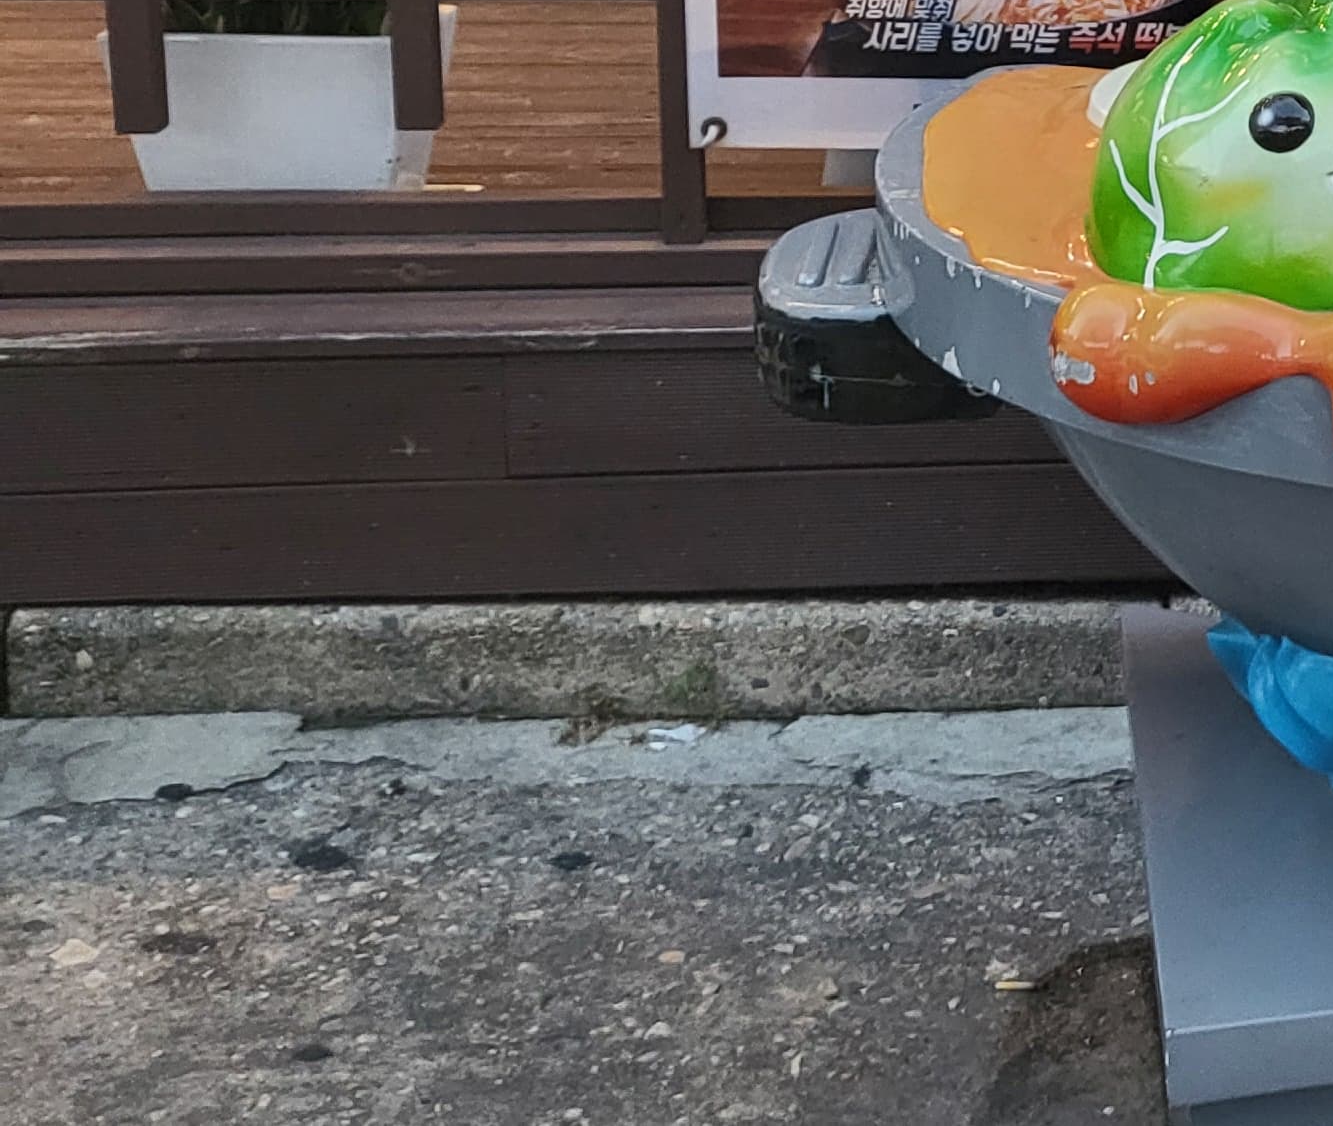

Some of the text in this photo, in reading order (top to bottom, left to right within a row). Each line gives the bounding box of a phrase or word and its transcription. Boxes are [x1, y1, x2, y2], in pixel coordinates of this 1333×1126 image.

[862, 22, 942, 53] 사리를
[1009, 22, 1061, 53] 먹는
[1068, 22, 1127, 54] 즉석
